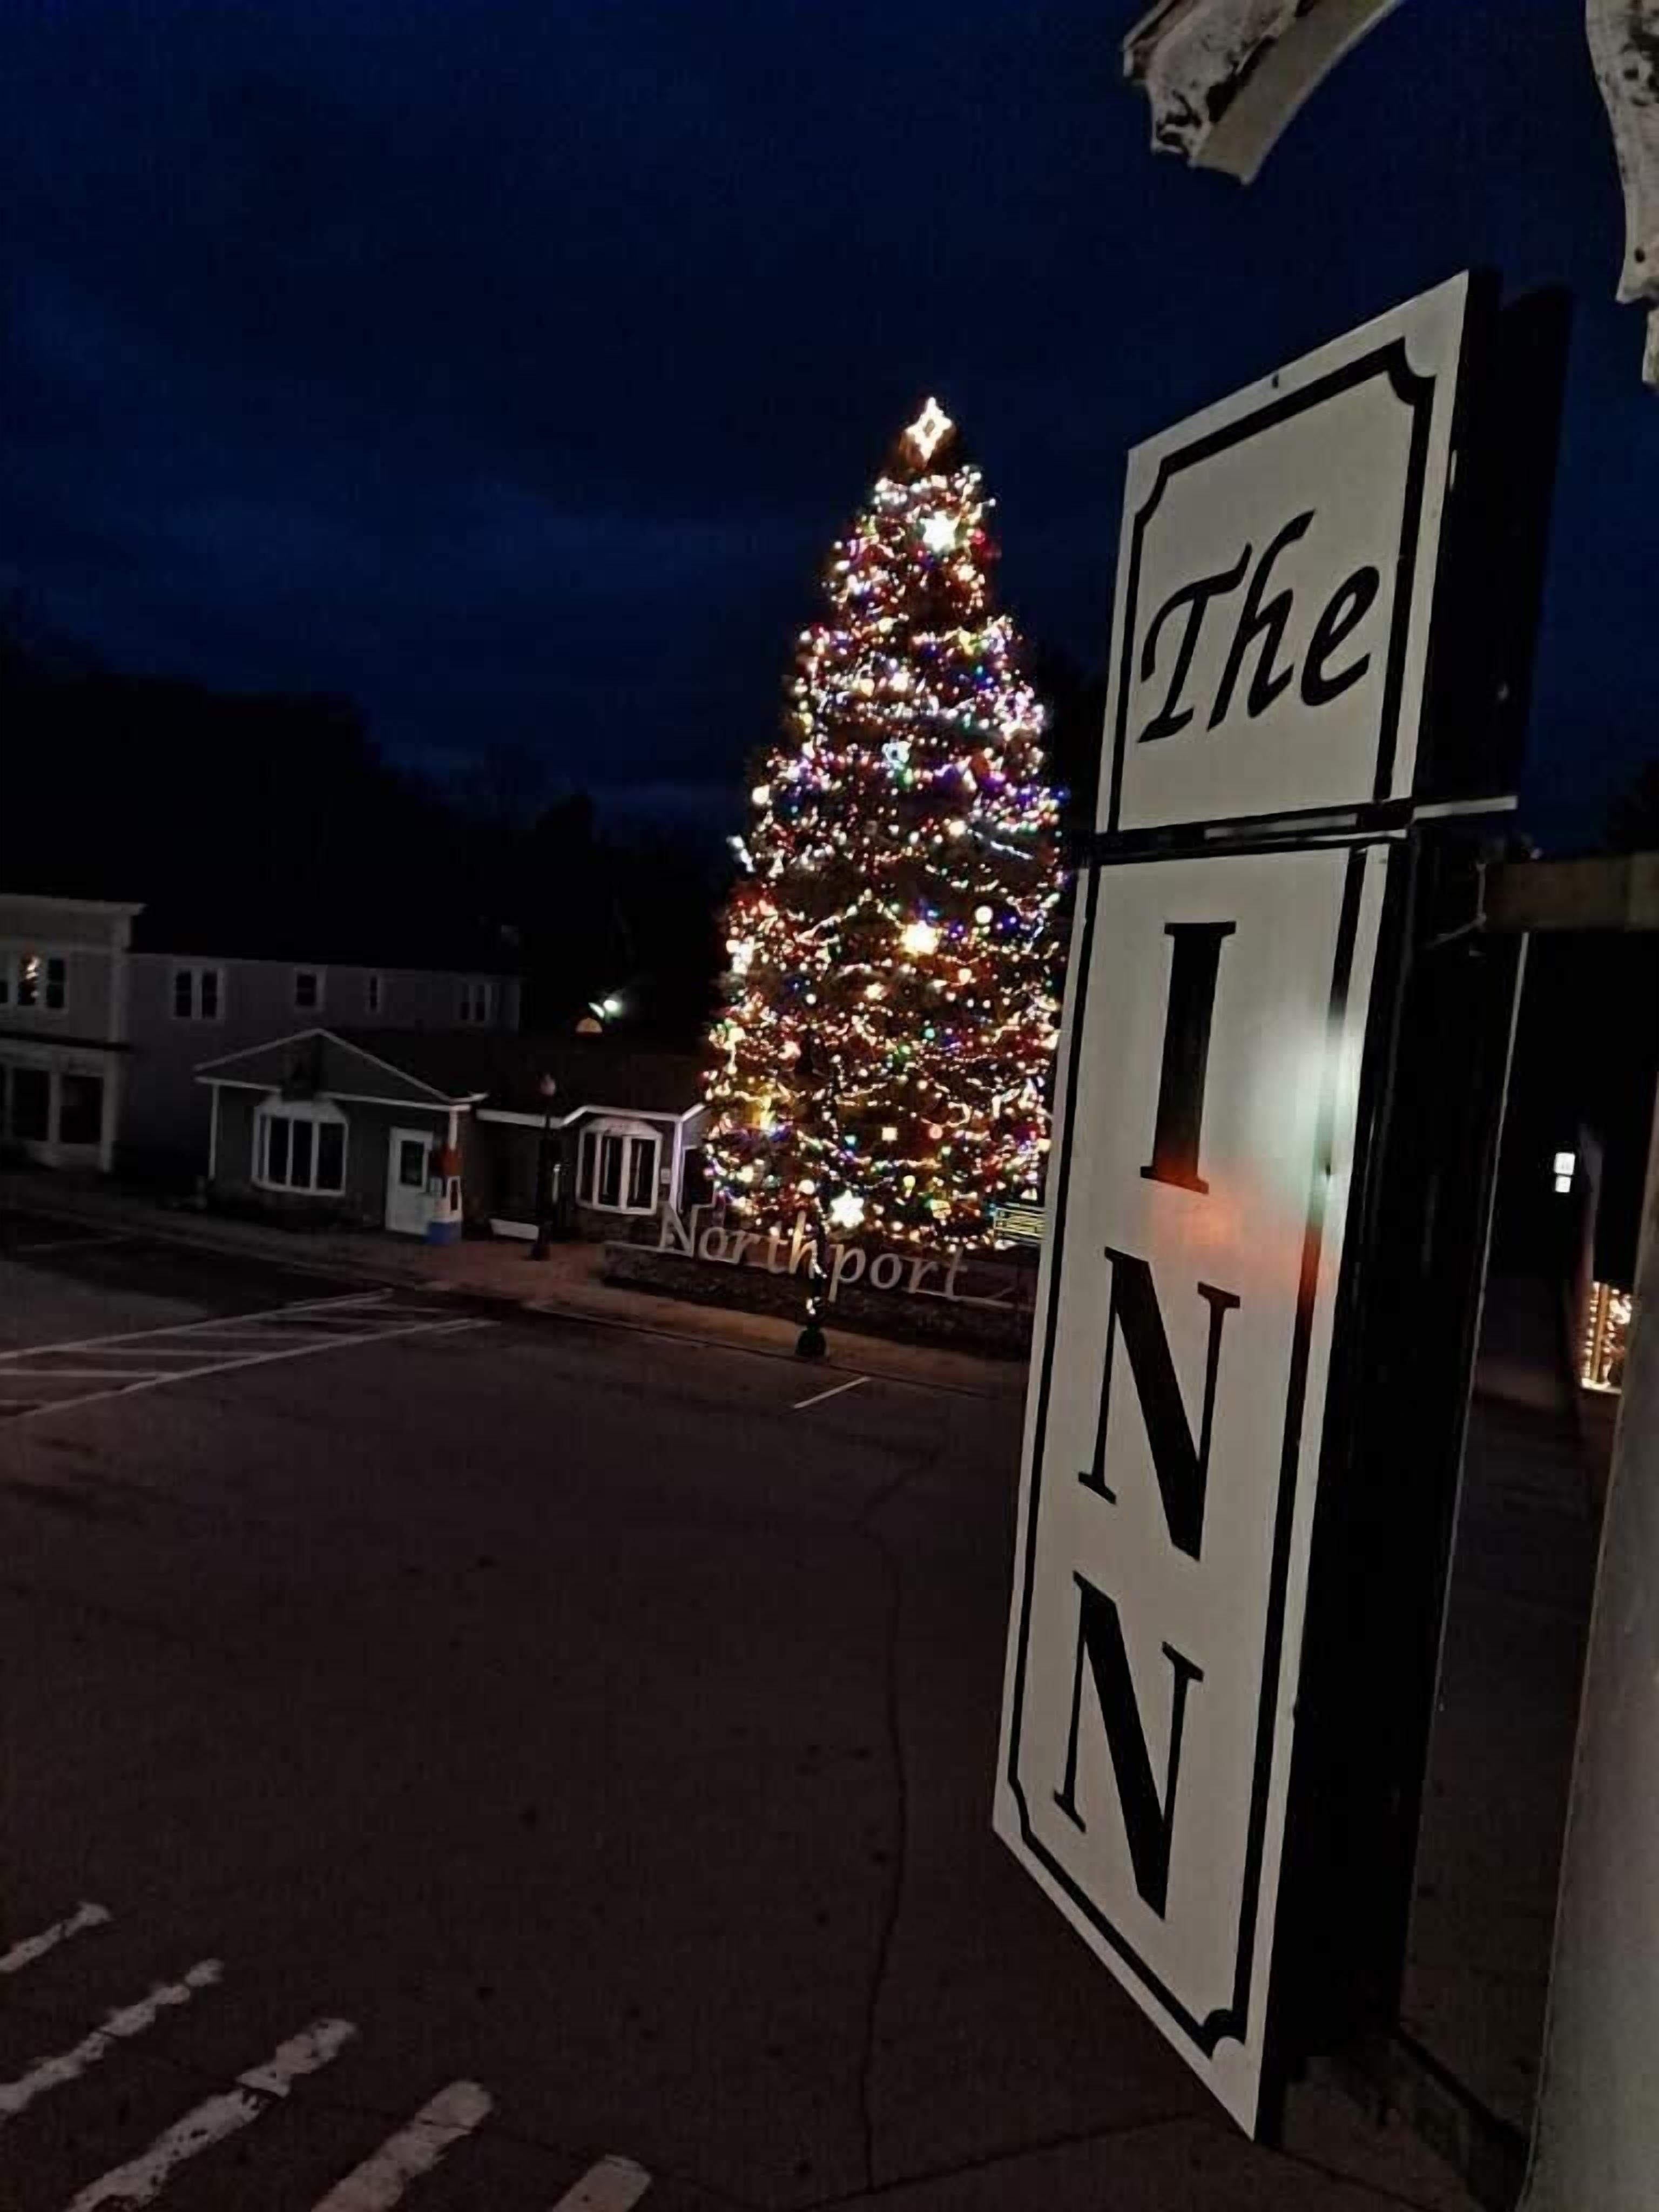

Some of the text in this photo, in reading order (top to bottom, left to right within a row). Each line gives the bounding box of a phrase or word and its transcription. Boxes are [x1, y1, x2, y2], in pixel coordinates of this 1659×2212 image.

[1139, 510, 1380, 742] The
[659, 1210, 967, 1302] Northport
[1054, 922, 1240, 1920] INN
